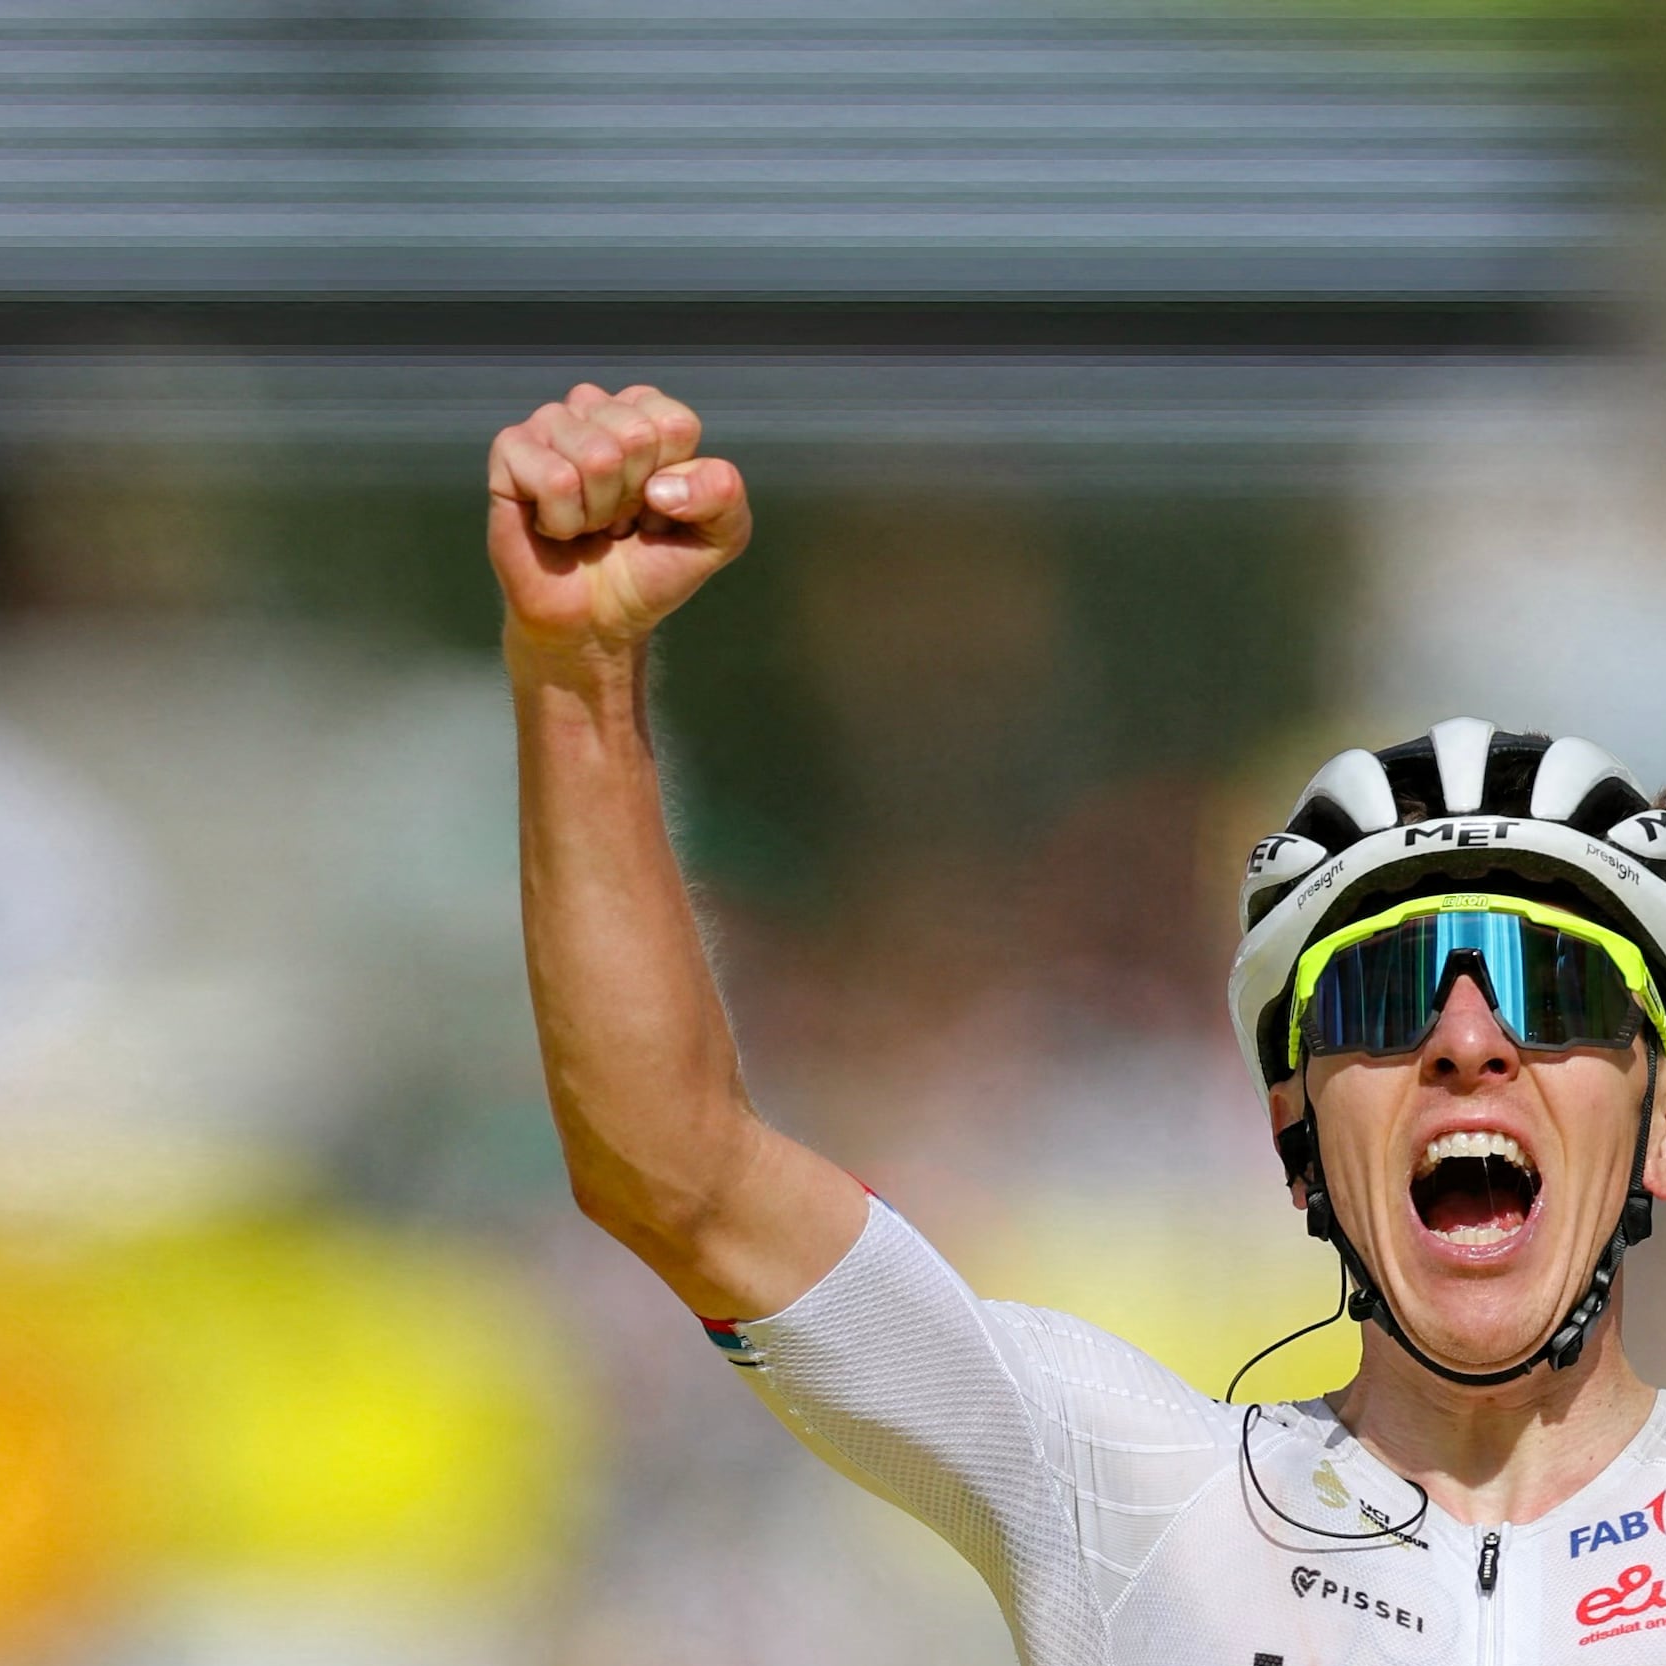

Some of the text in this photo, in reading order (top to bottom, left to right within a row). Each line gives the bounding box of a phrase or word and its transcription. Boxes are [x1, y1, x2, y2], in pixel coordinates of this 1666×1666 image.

[1405, 822, 1520, 847] MET
[1247, 836, 1300, 873] ET
[1586, 843, 1640, 886] presight
[1296, 859, 1345, 910] presight
[1359, 1498, 1390, 1525] UCI
[1321, 1579, 1424, 1633] PISSEI
[1578, 1621, 1642, 1646] etisalat
